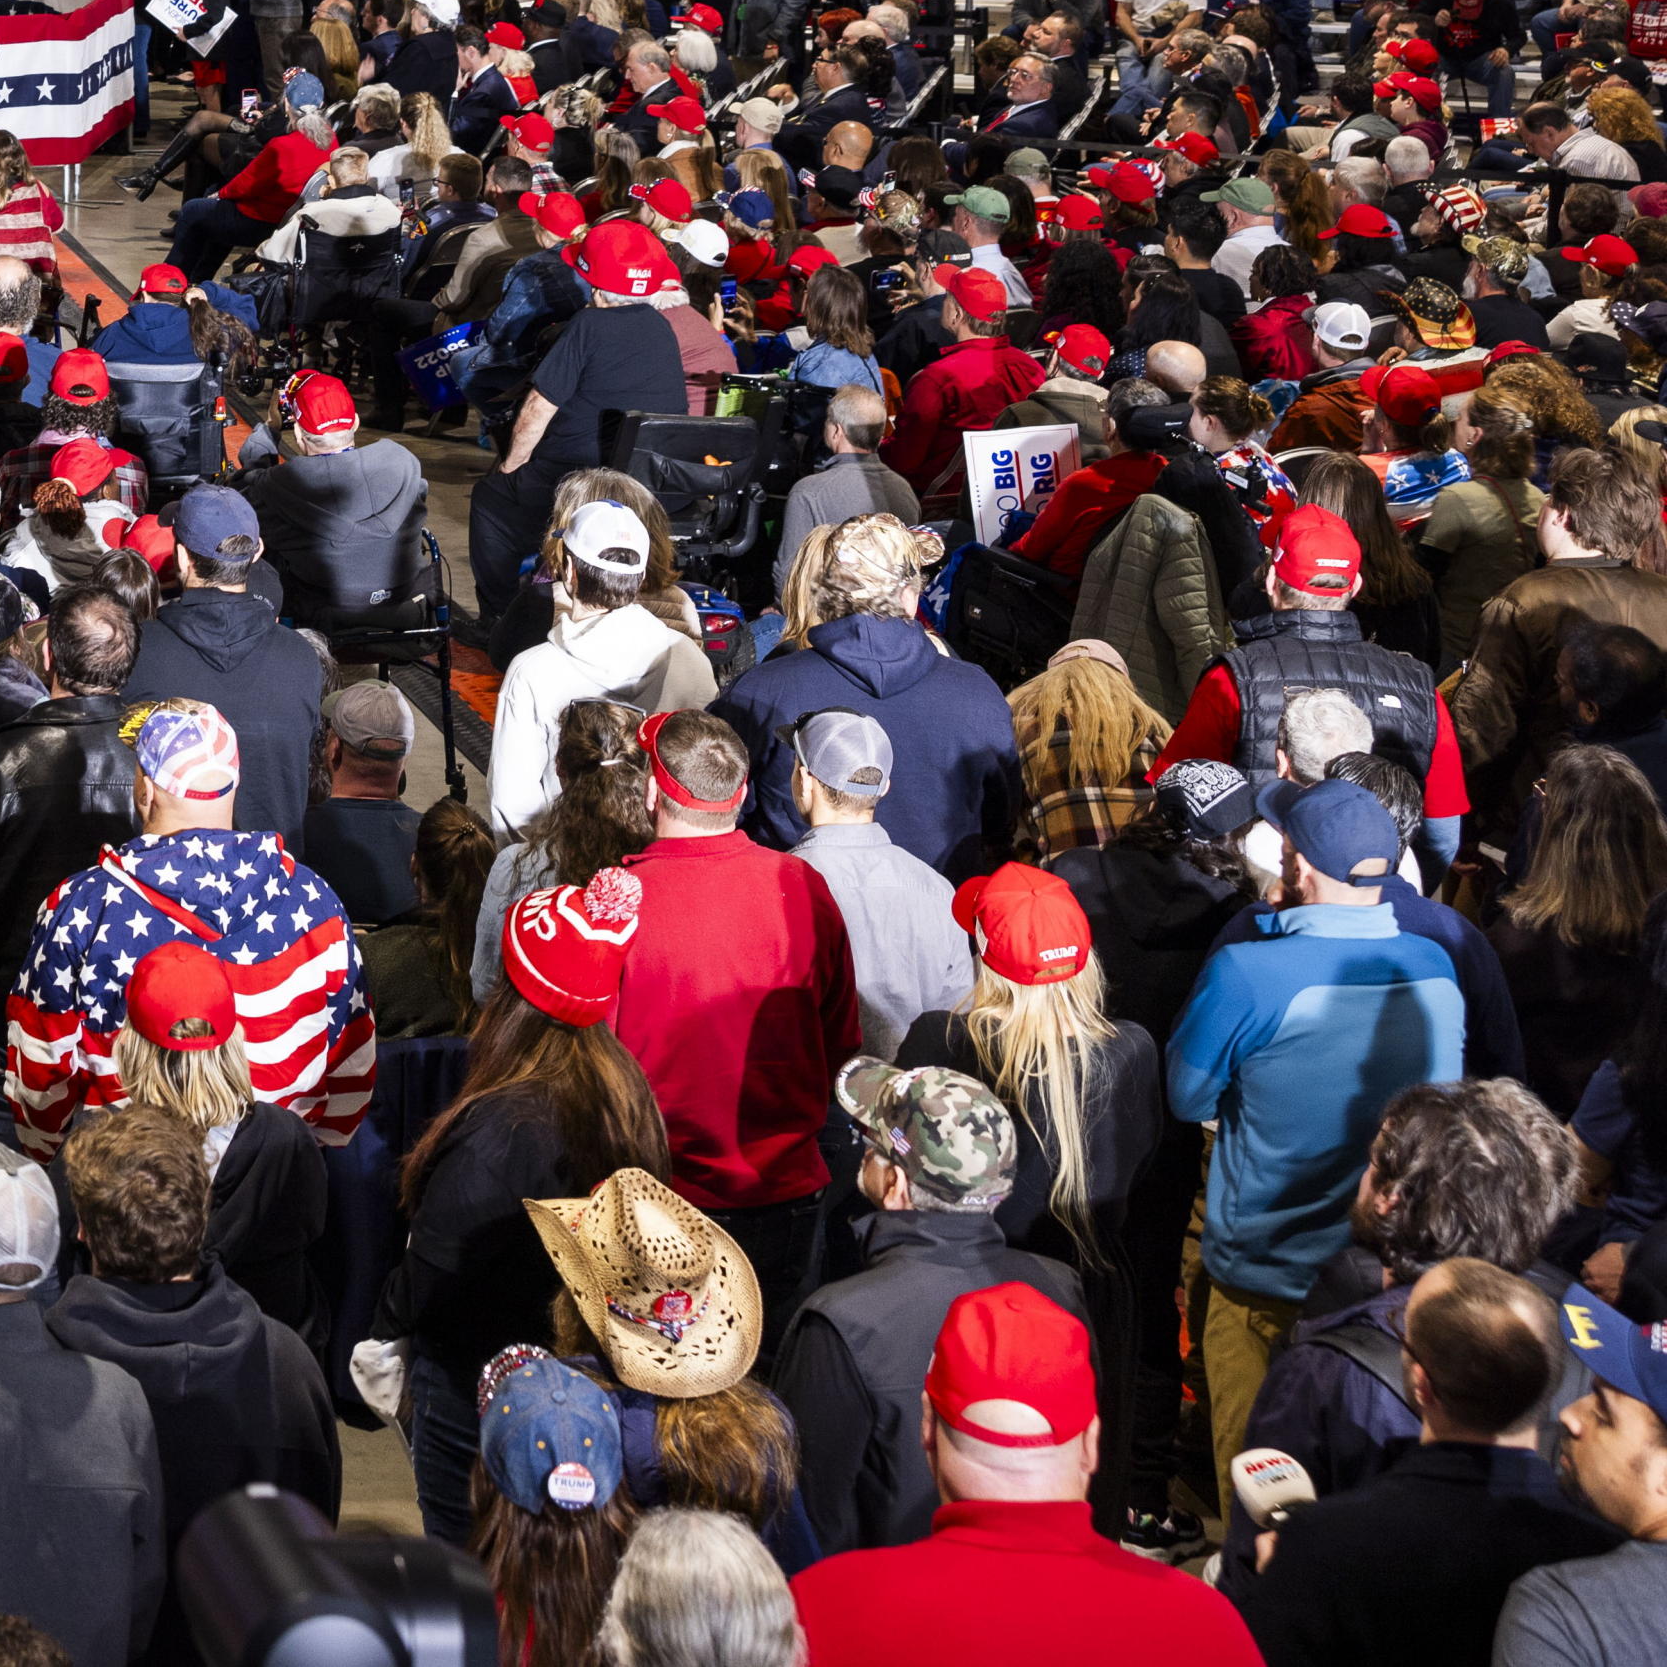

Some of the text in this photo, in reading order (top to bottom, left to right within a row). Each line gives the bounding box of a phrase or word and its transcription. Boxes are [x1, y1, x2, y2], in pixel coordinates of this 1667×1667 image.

[628, 268, 652, 279] MAGA
[990, 448, 1012, 488] BIG
[1029, 452, 1051, 493] RIG
[1039, 946, 1078, 962] TRUMP
[963, 1197, 987, 1205] USA
[1244, 1457, 1292, 1476] NEWS
[553, 1477, 593, 1490] TRUMP
